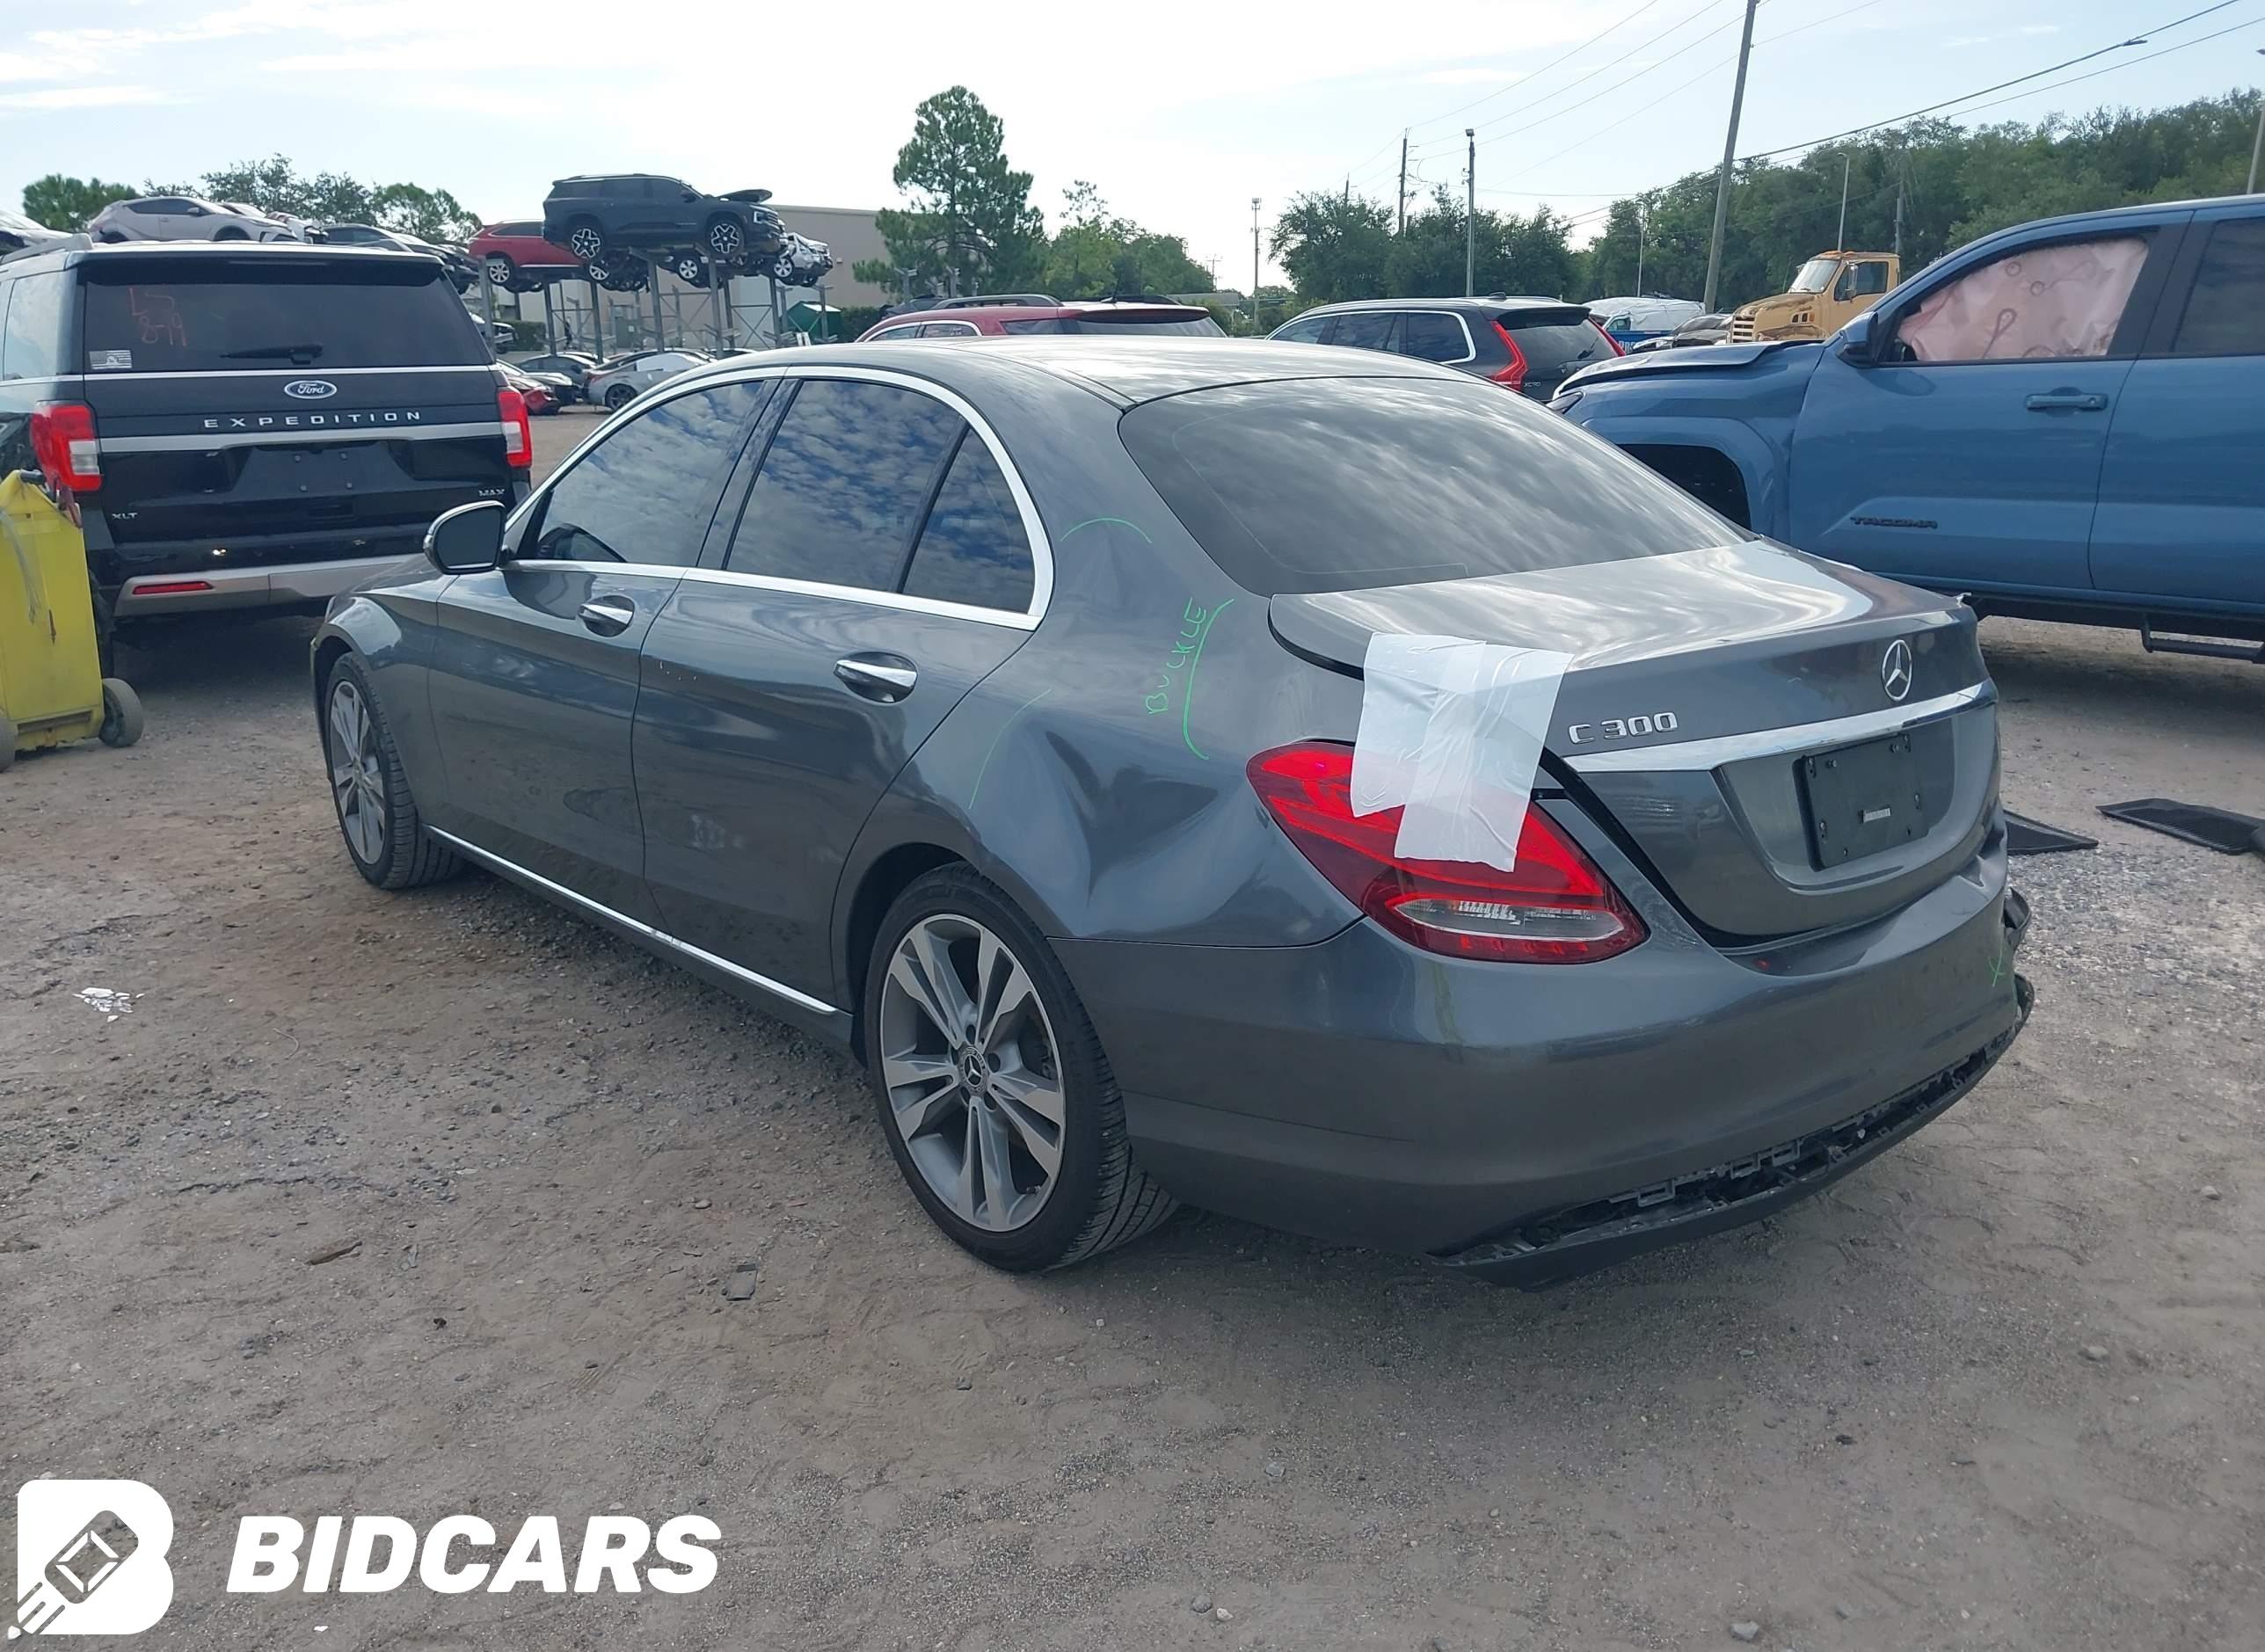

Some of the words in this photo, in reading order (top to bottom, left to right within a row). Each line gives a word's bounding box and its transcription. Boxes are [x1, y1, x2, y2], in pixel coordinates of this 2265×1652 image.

[296, 382, 325, 395] Ford
[204, 411, 421, 428] EXPEDITION
[1849, 517, 1939, 529] TACOMA
[1146, 597, 1206, 715] BUCKLE
[1569, 724, 1594, 744] C
[1601, 711, 1679, 739] 300
